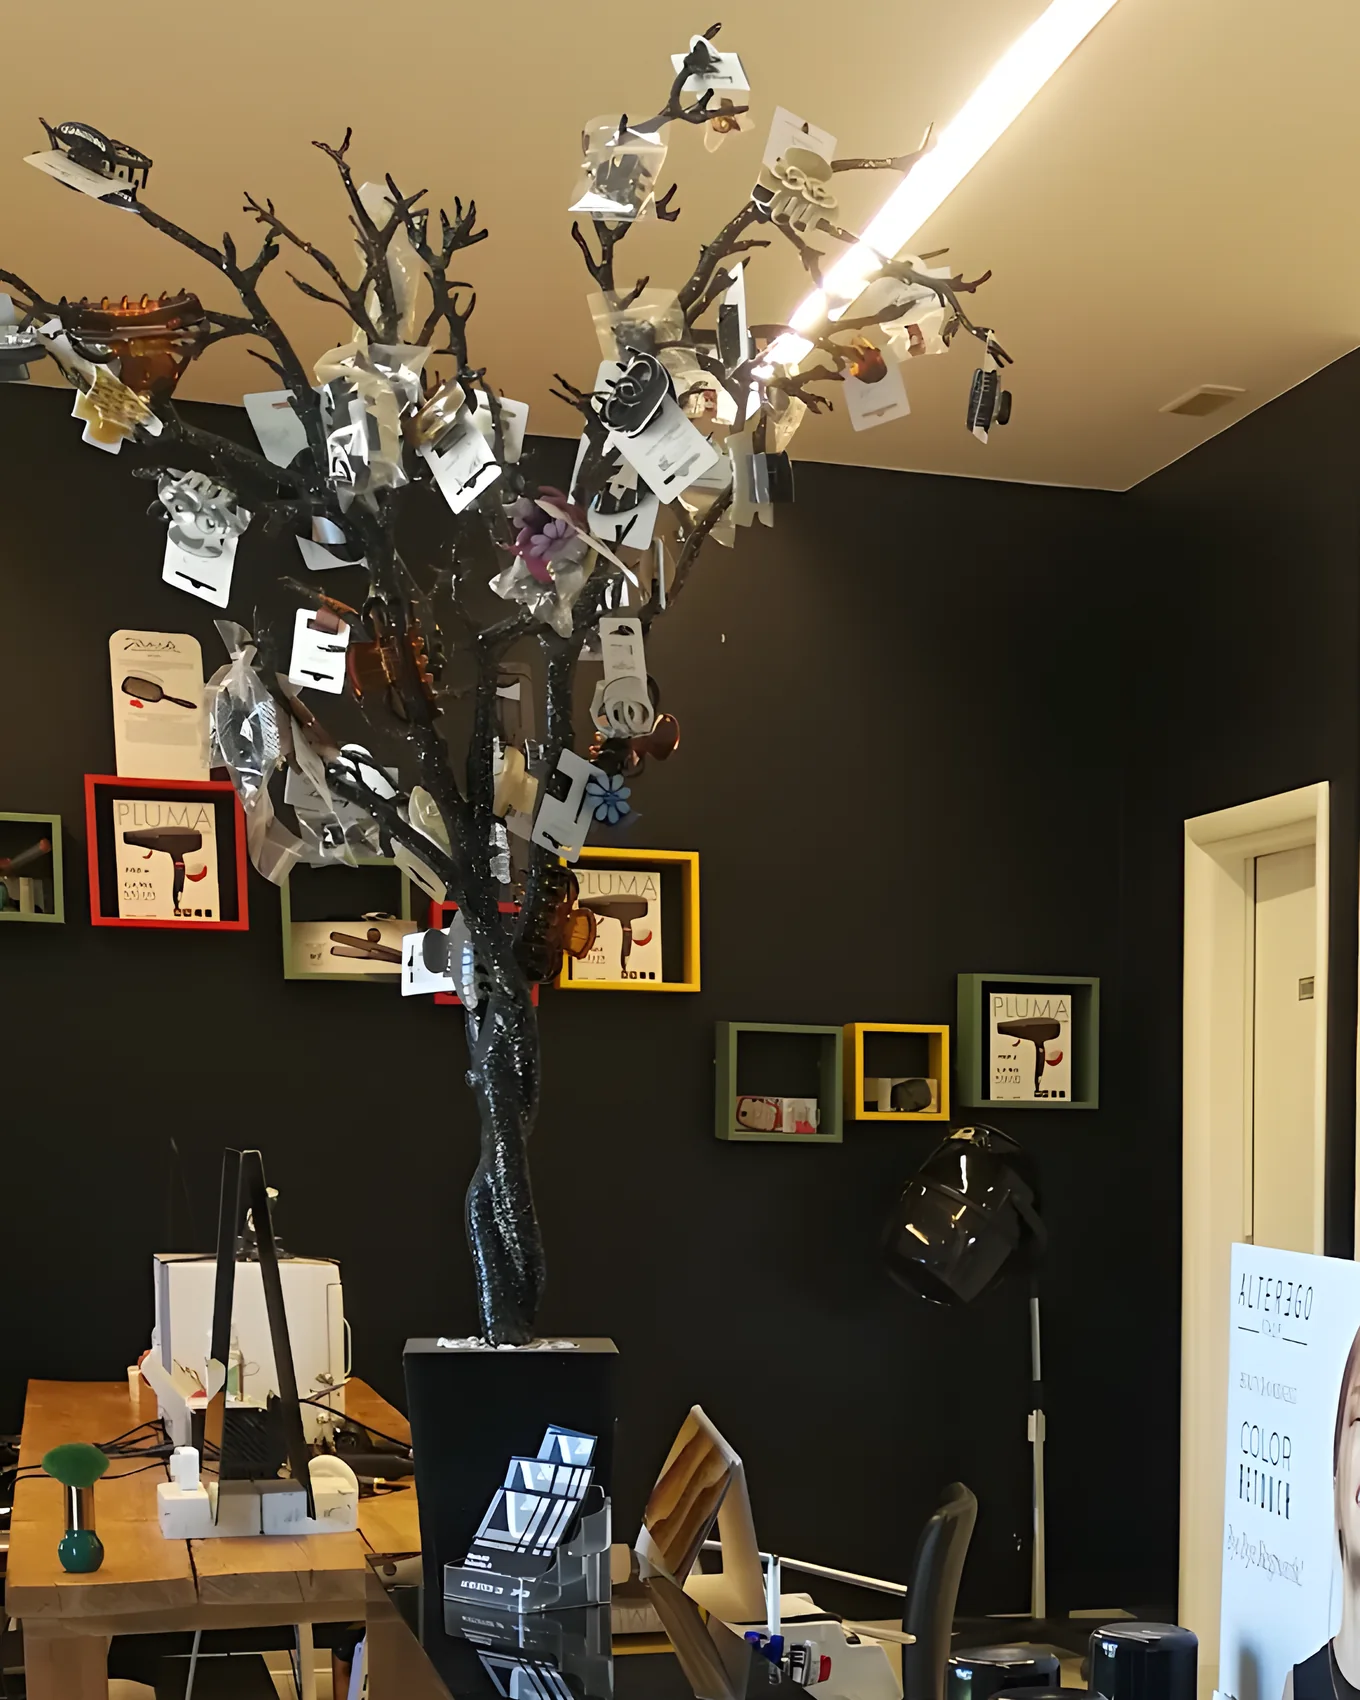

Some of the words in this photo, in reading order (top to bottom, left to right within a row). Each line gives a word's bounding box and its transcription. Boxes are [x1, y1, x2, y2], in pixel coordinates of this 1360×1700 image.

[118, 803, 212, 831] PLUMA
[994, 996, 1069, 1019] PLUMA
[1240, 1420, 1292, 1472] COLOR
